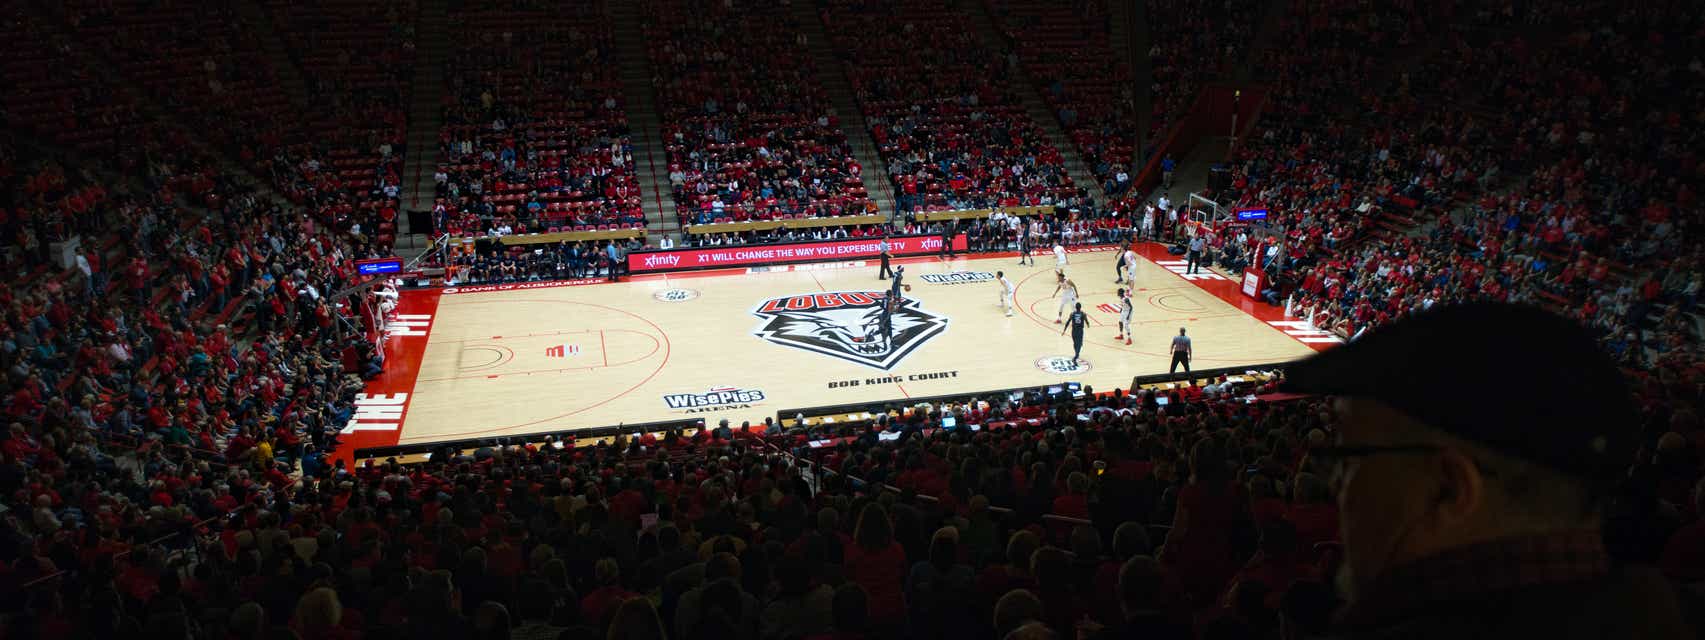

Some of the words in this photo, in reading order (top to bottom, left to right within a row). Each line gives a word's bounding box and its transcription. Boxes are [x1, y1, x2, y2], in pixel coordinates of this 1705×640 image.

[921, 238, 944, 250] xfini
[698, 254, 710, 262] X1
[712, 252, 734, 261] WILL
[735, 249, 774, 260] CHANGE
[776, 248, 793, 257] THE
[795, 247, 815, 256] WAY
[816, 246, 836, 255] YOU
[837, 242, 893, 255] EXPERIENE
[894, 242, 905, 250] TV
[645, 254, 680, 268] xfinity
[518, 280, 604, 288] ALBUQUERQUE
[828, 379, 860, 389] BOB
[865, 376, 904, 385] KING
[908, 371, 959, 381] COURT
[664, 390, 765, 408] WisePies
[685, 404, 752, 414] ARENA
